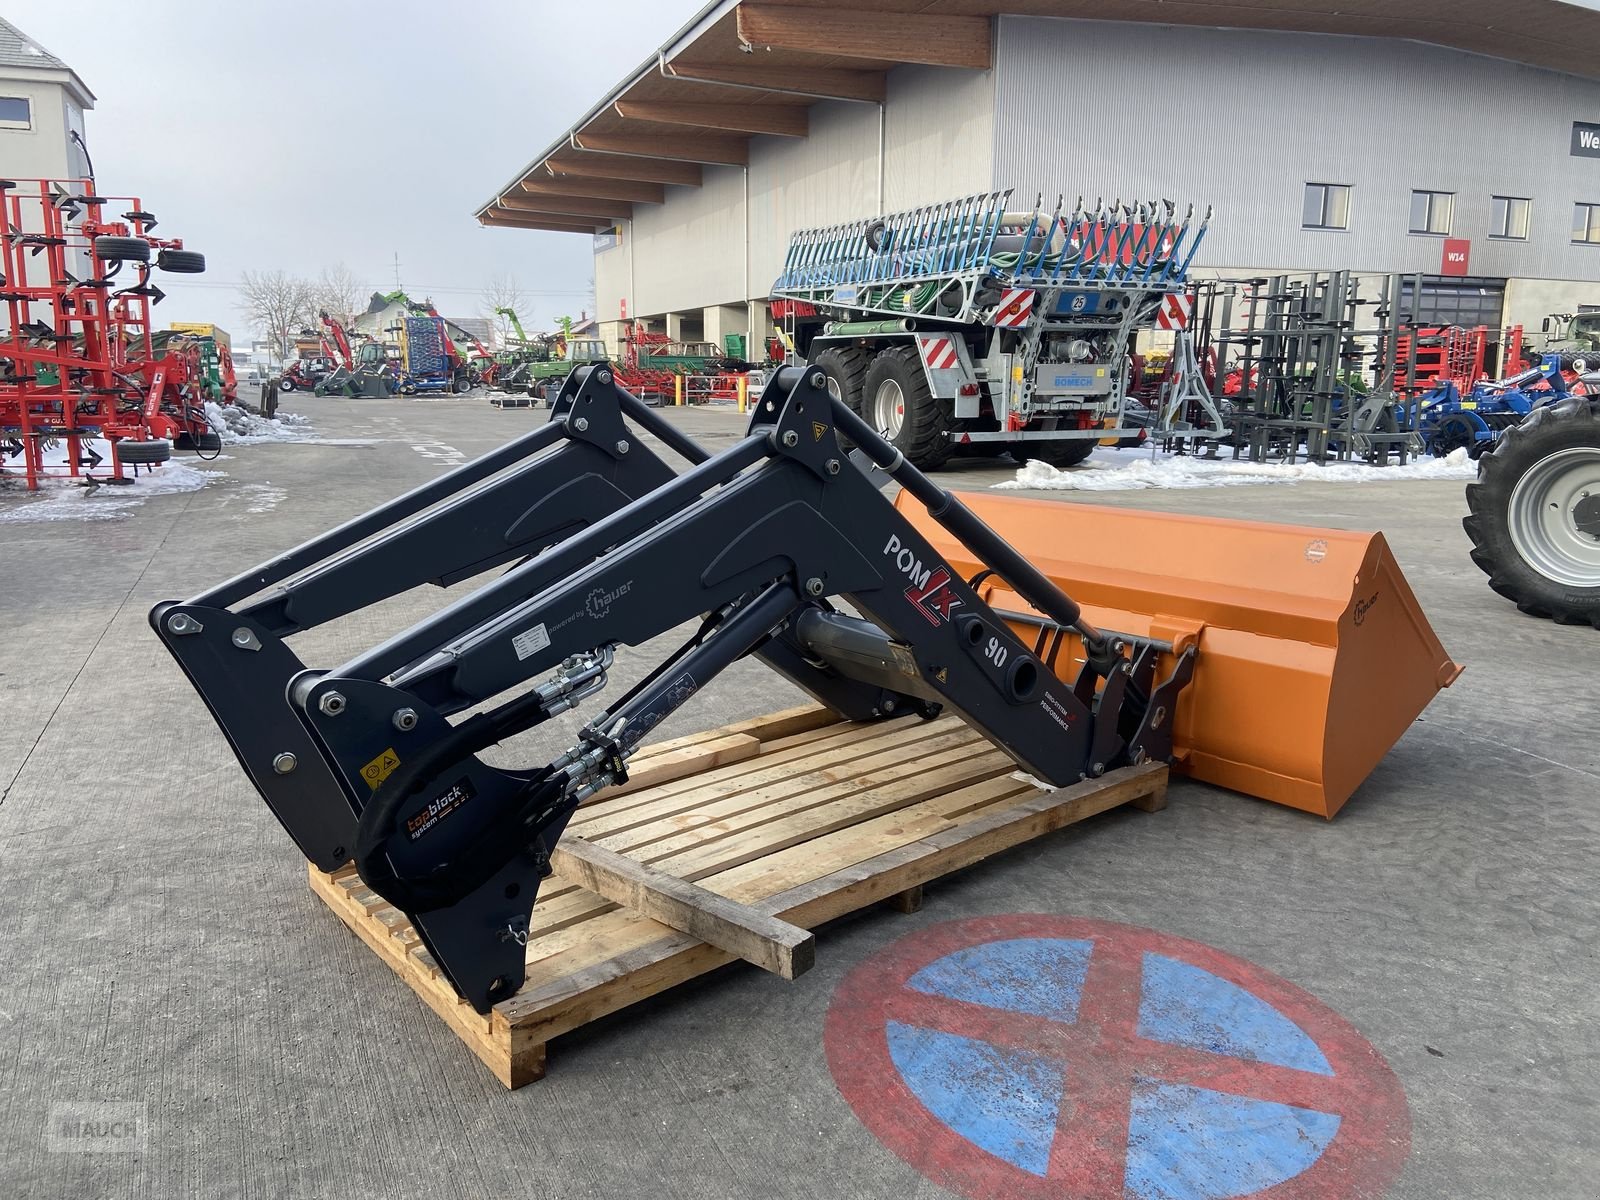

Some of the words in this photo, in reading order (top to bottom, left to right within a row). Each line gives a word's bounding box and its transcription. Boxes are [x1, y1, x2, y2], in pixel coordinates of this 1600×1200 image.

[1579, 130, 1600, 149] We
[1448, 252, 1465, 262] W14
[1073, 297, 1085, 309] 25
[1055, 376, 1093, 387] BOMECH
[984, 636, 1008, 668] 90
[1040, 700, 1070, 731] PERFORMANCE
[407, 786, 462, 832] topblock
[411, 816, 438, 840] system
